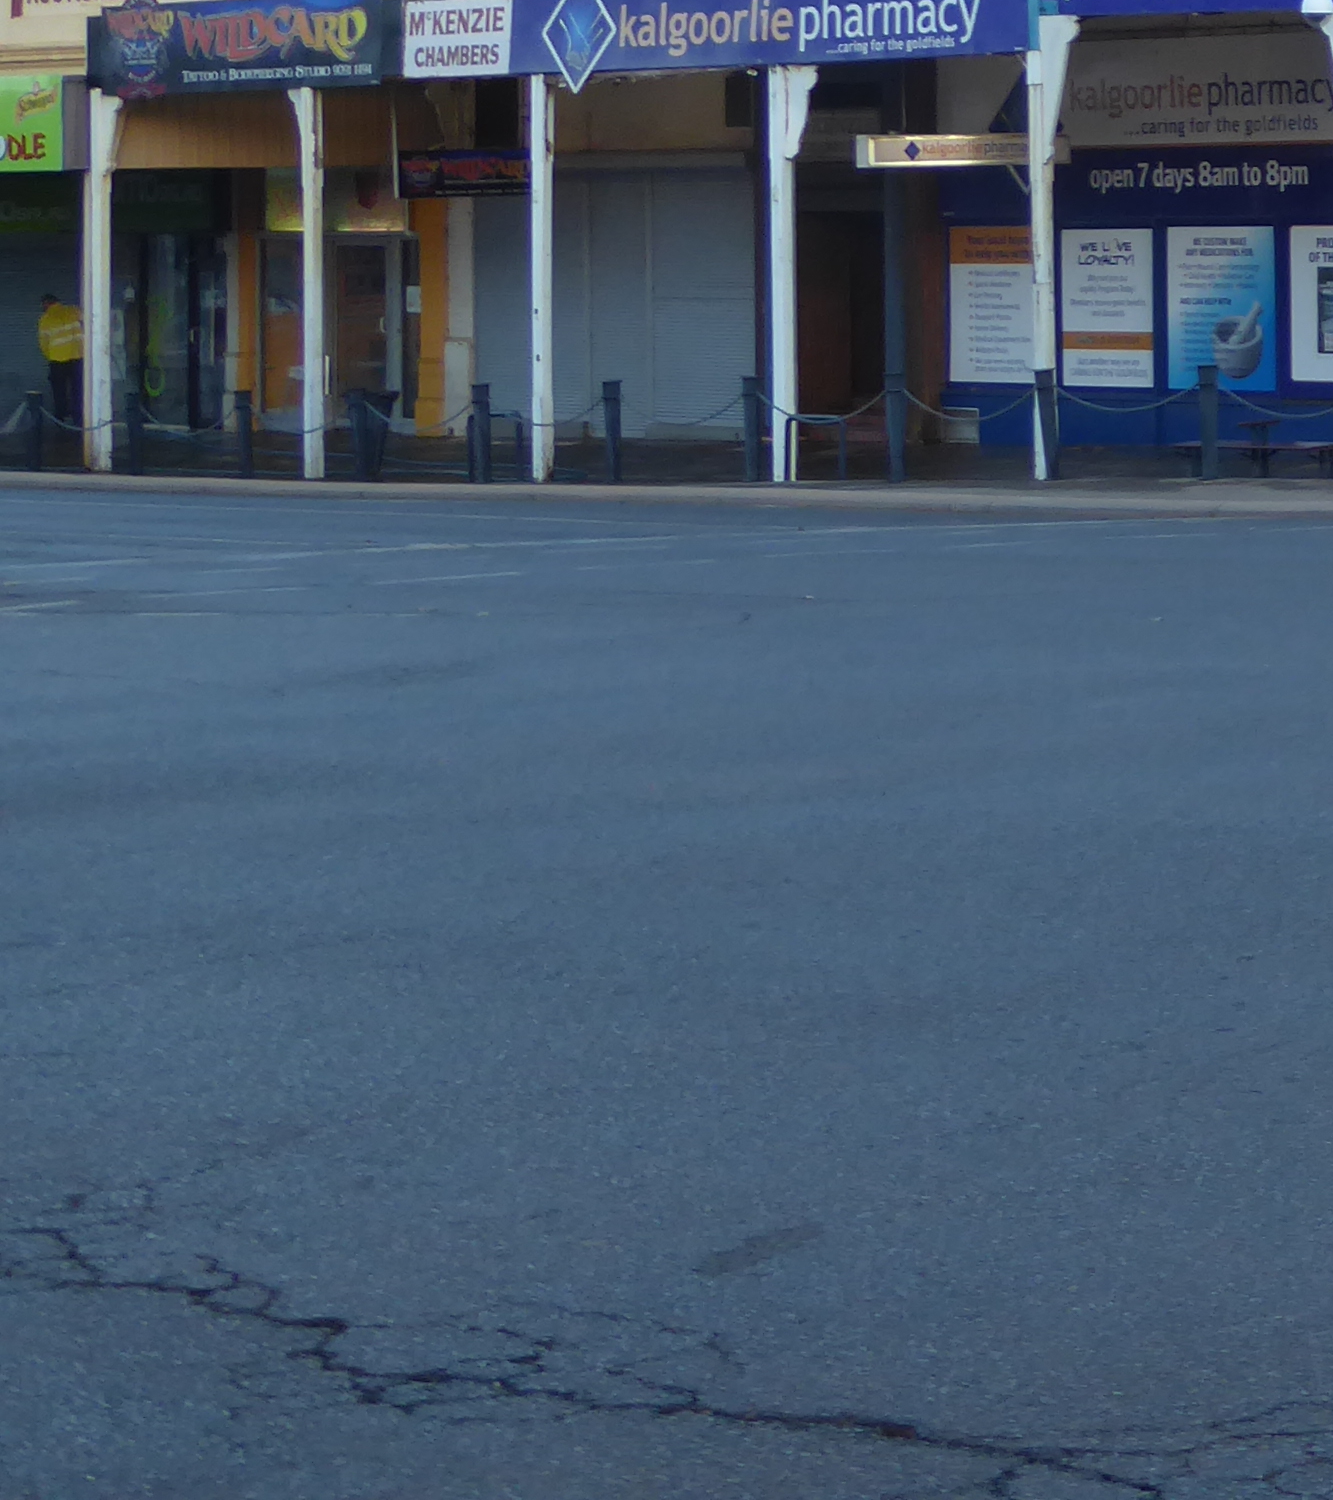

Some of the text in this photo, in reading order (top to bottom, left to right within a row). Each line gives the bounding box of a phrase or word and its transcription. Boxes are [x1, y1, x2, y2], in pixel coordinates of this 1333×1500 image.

[177, 5, 366, 62] WILDCARD
[870, 39, 886, 51] for
[888, 38, 904, 50] the
[414, 44, 499, 67] CHAMBERS
[1190, 117, 1210, 133] for
[1216, 116, 1239, 132] the
[1245, 114, 1318, 135] goldfields
[1090, 160, 1309, 194] open 7 days 8am to 8pm
